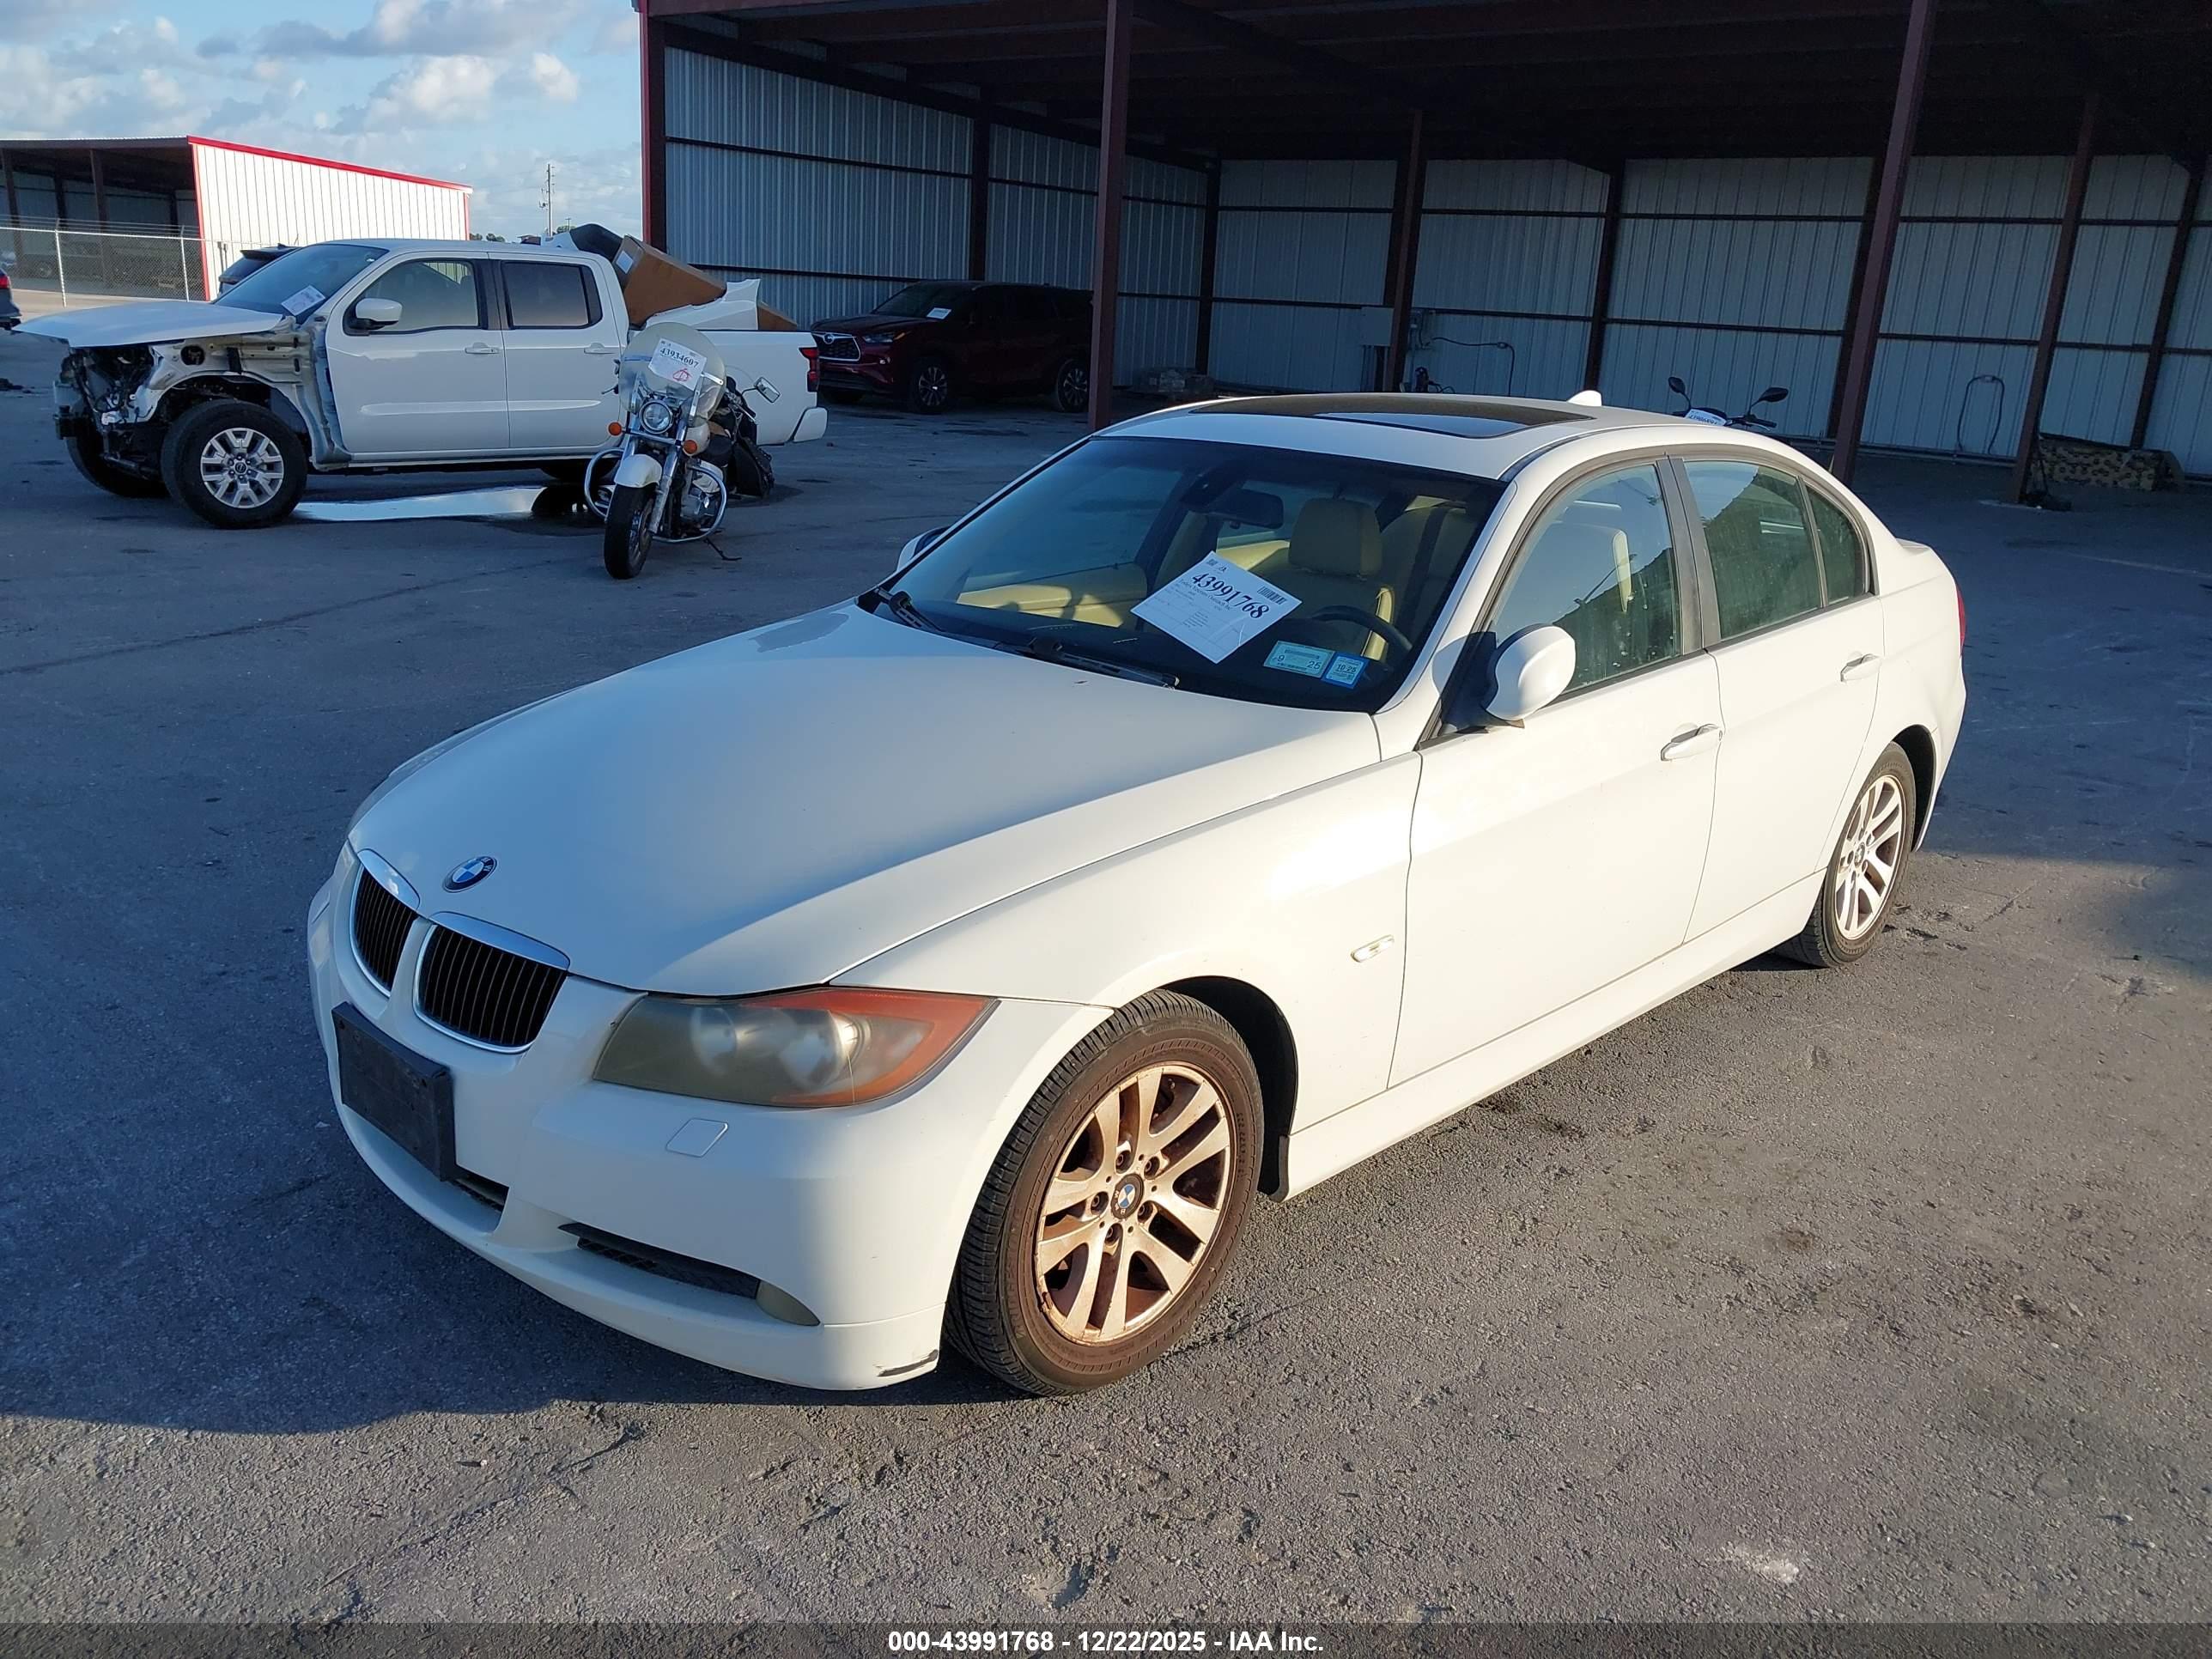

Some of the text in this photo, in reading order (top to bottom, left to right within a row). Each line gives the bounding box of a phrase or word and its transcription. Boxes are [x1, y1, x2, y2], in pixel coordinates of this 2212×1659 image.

[659, 347, 700, 368] 43934607
[1191, 573, 1270, 619] 43991768
[1306, 660, 1322, 670] 25
